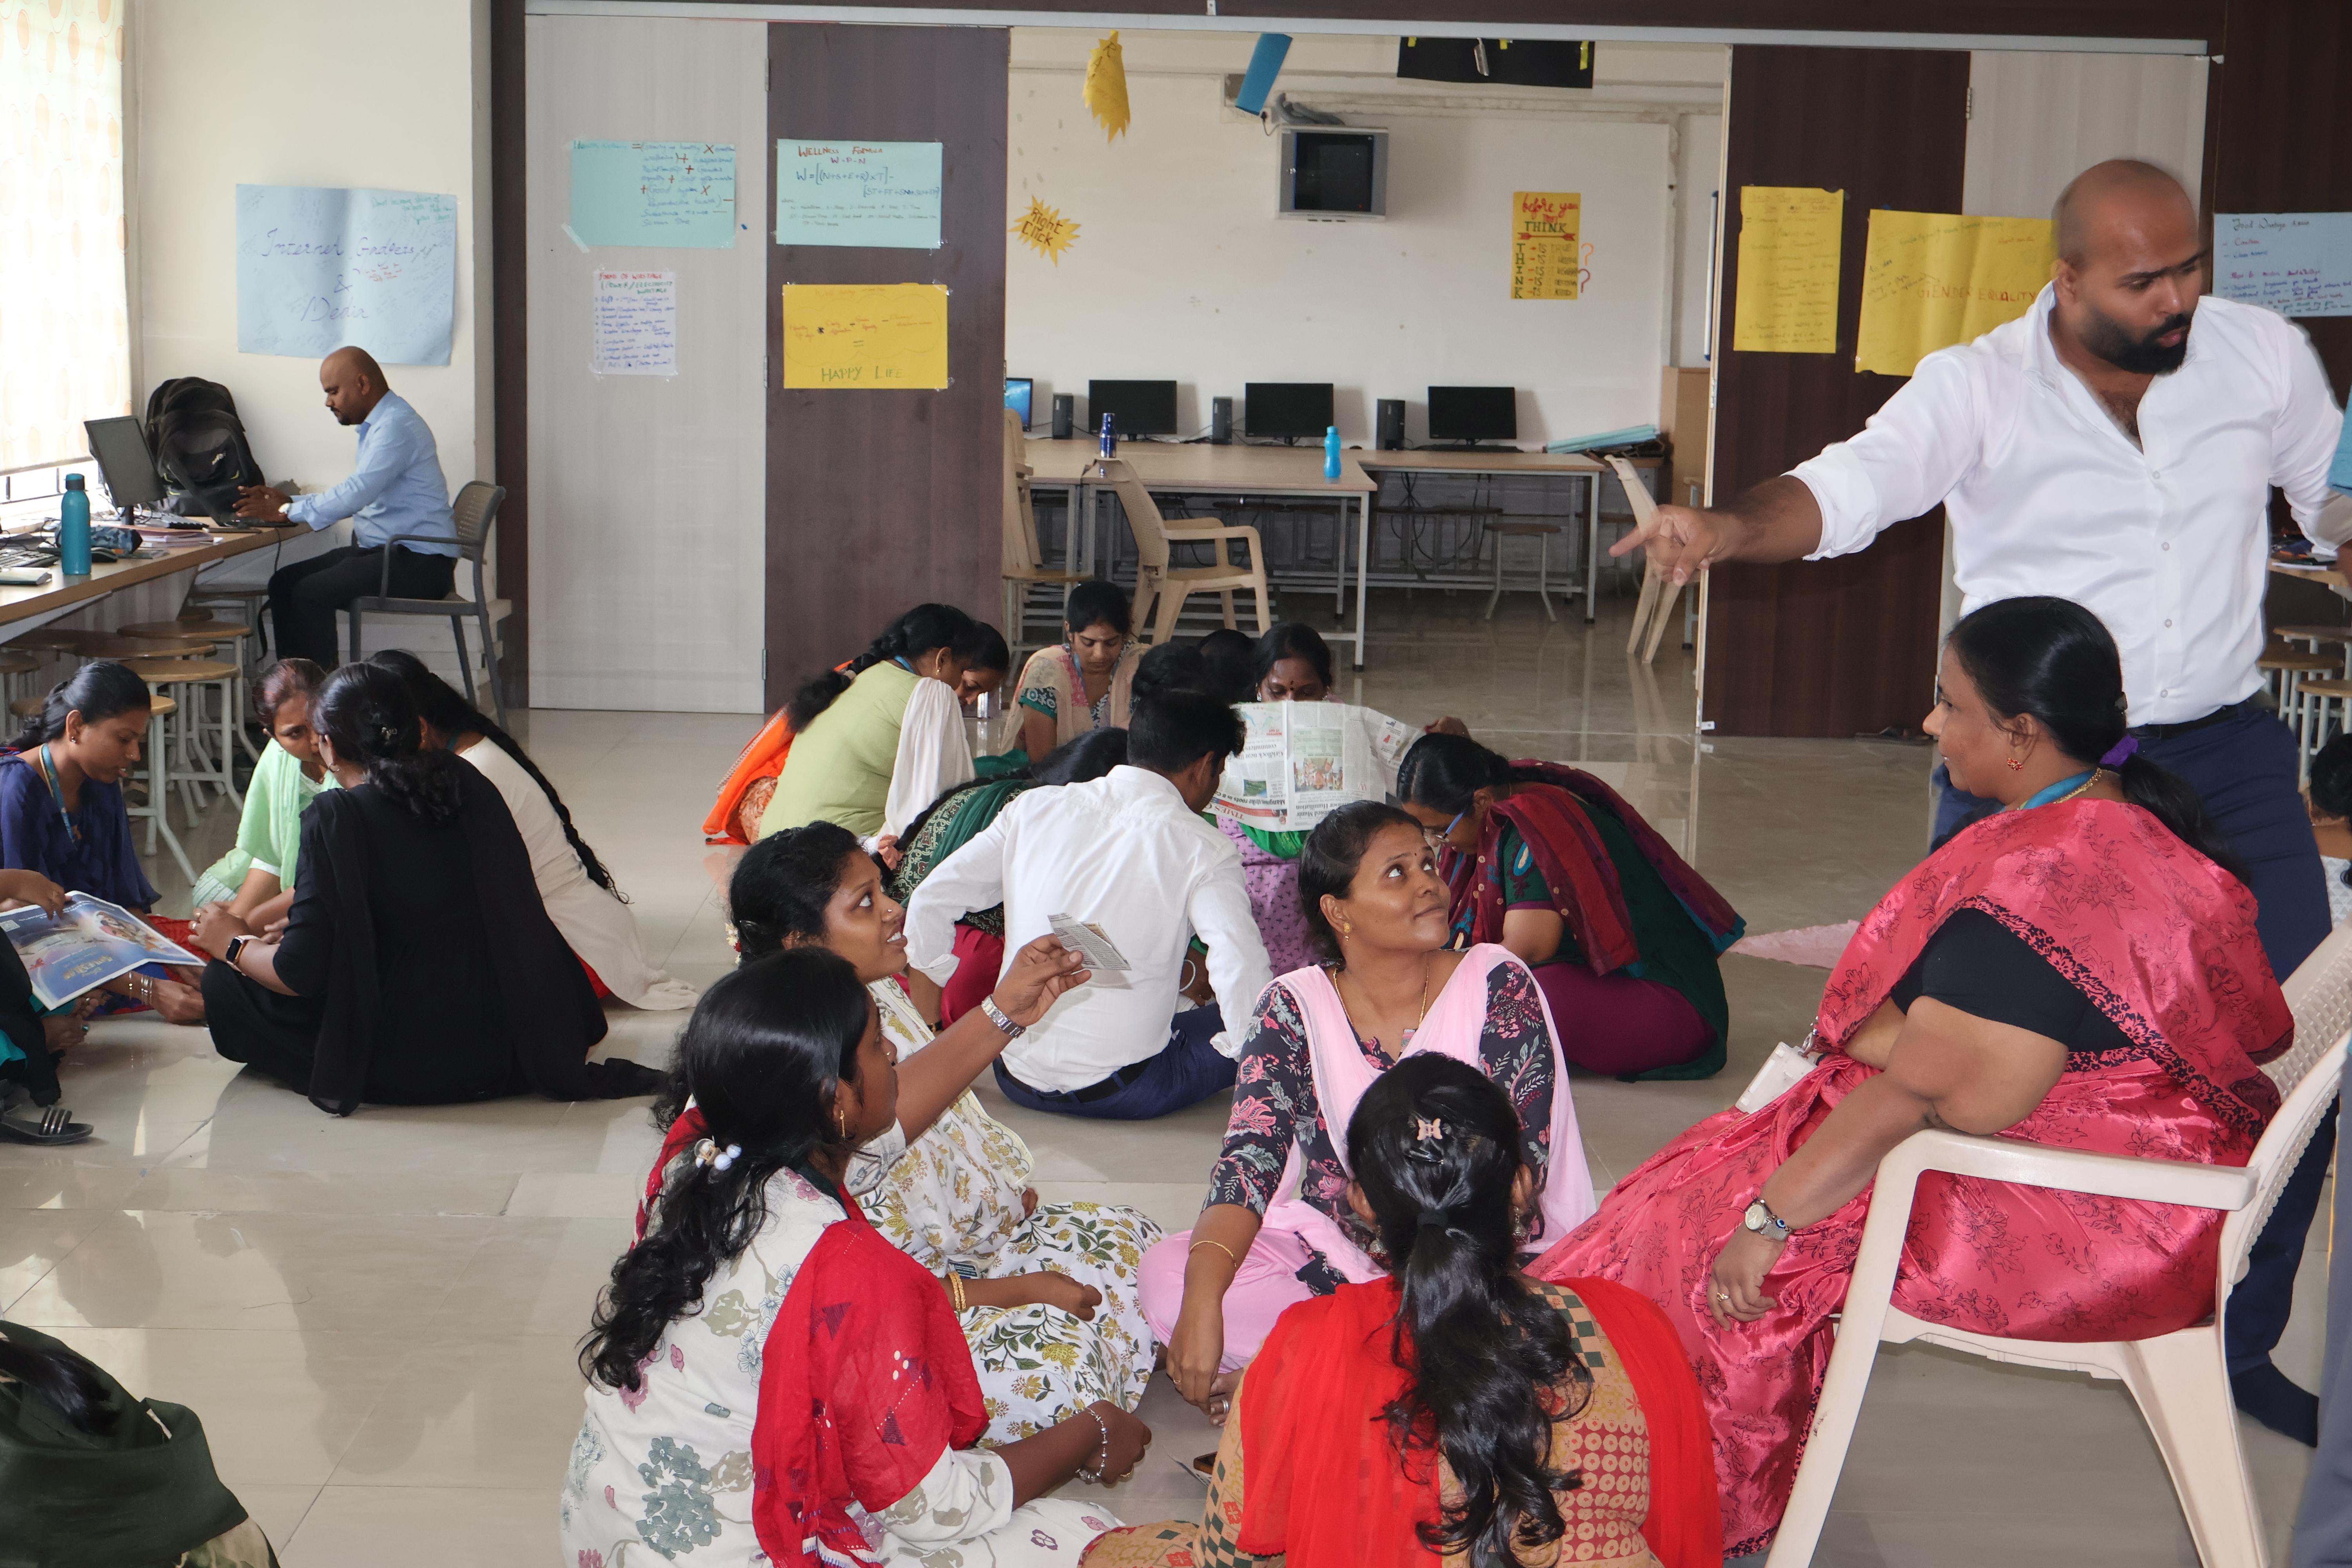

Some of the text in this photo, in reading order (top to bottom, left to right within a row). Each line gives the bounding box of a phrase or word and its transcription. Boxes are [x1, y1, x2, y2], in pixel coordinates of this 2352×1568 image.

[1524, 221, 1567, 233] THINK
[261, 227, 344, 257] Internet
[821, 365, 903, 382] HAPPY LIFE
[1258, 751, 1283, 760] Gridlock
[1214, 805, 1245, 820] TIMES
[1296, 803, 1328, 811] Humiliation
